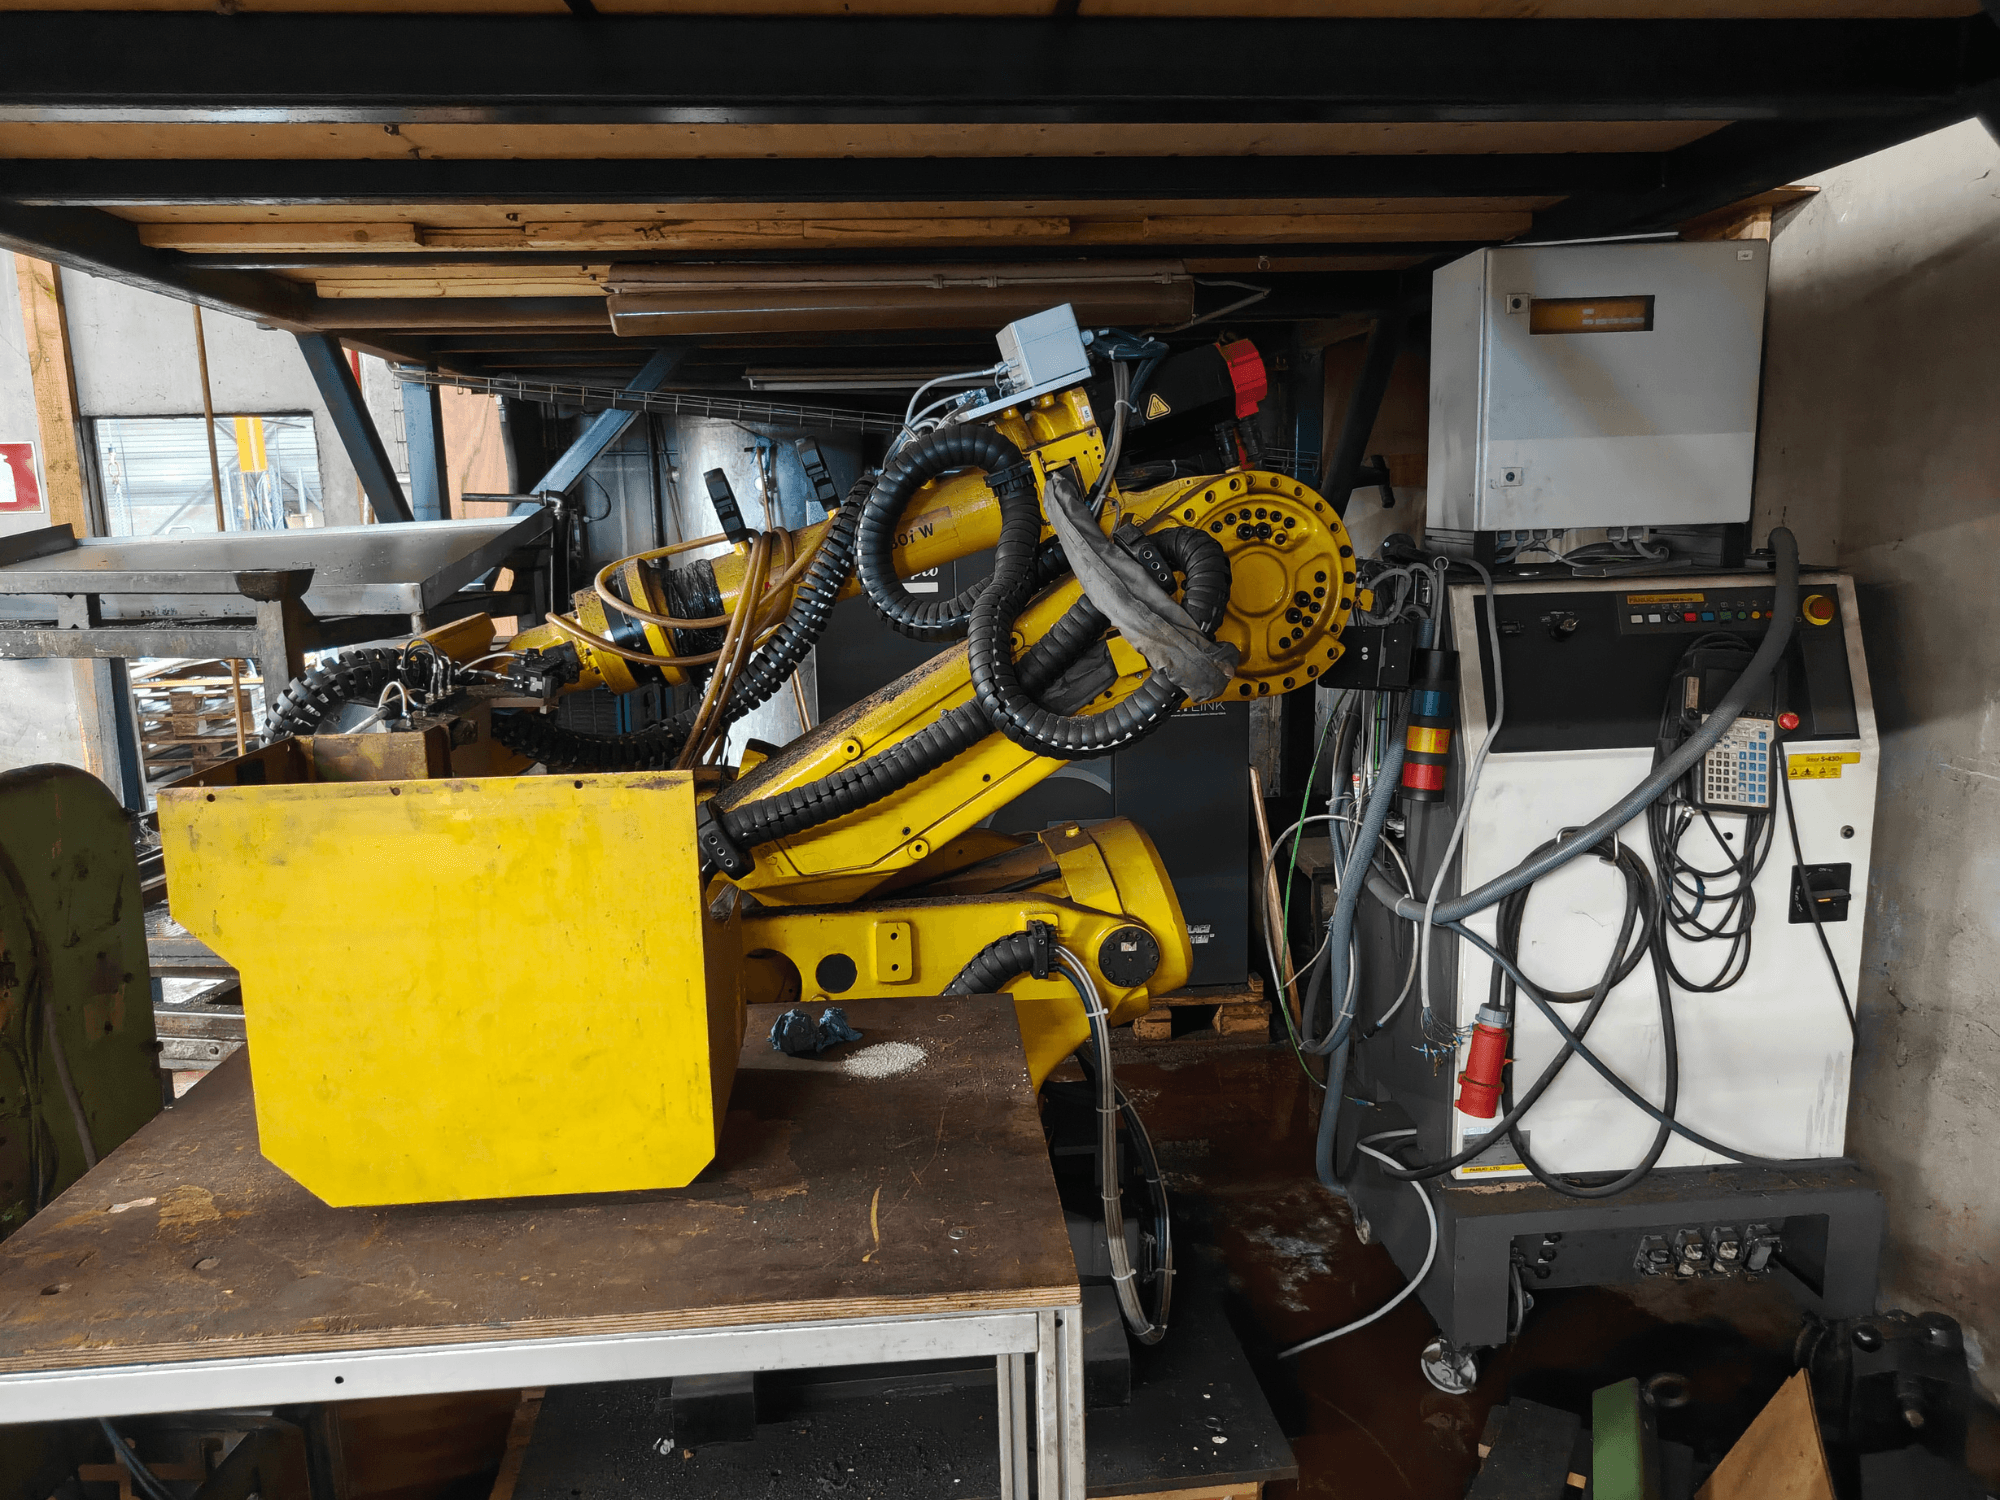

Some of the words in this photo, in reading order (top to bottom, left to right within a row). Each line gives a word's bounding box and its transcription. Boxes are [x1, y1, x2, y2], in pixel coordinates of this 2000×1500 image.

[918, 522, 934, 538] W
[1187, 924, 1211, 934] LACE
[1190, 934, 1209, 944] TEM
